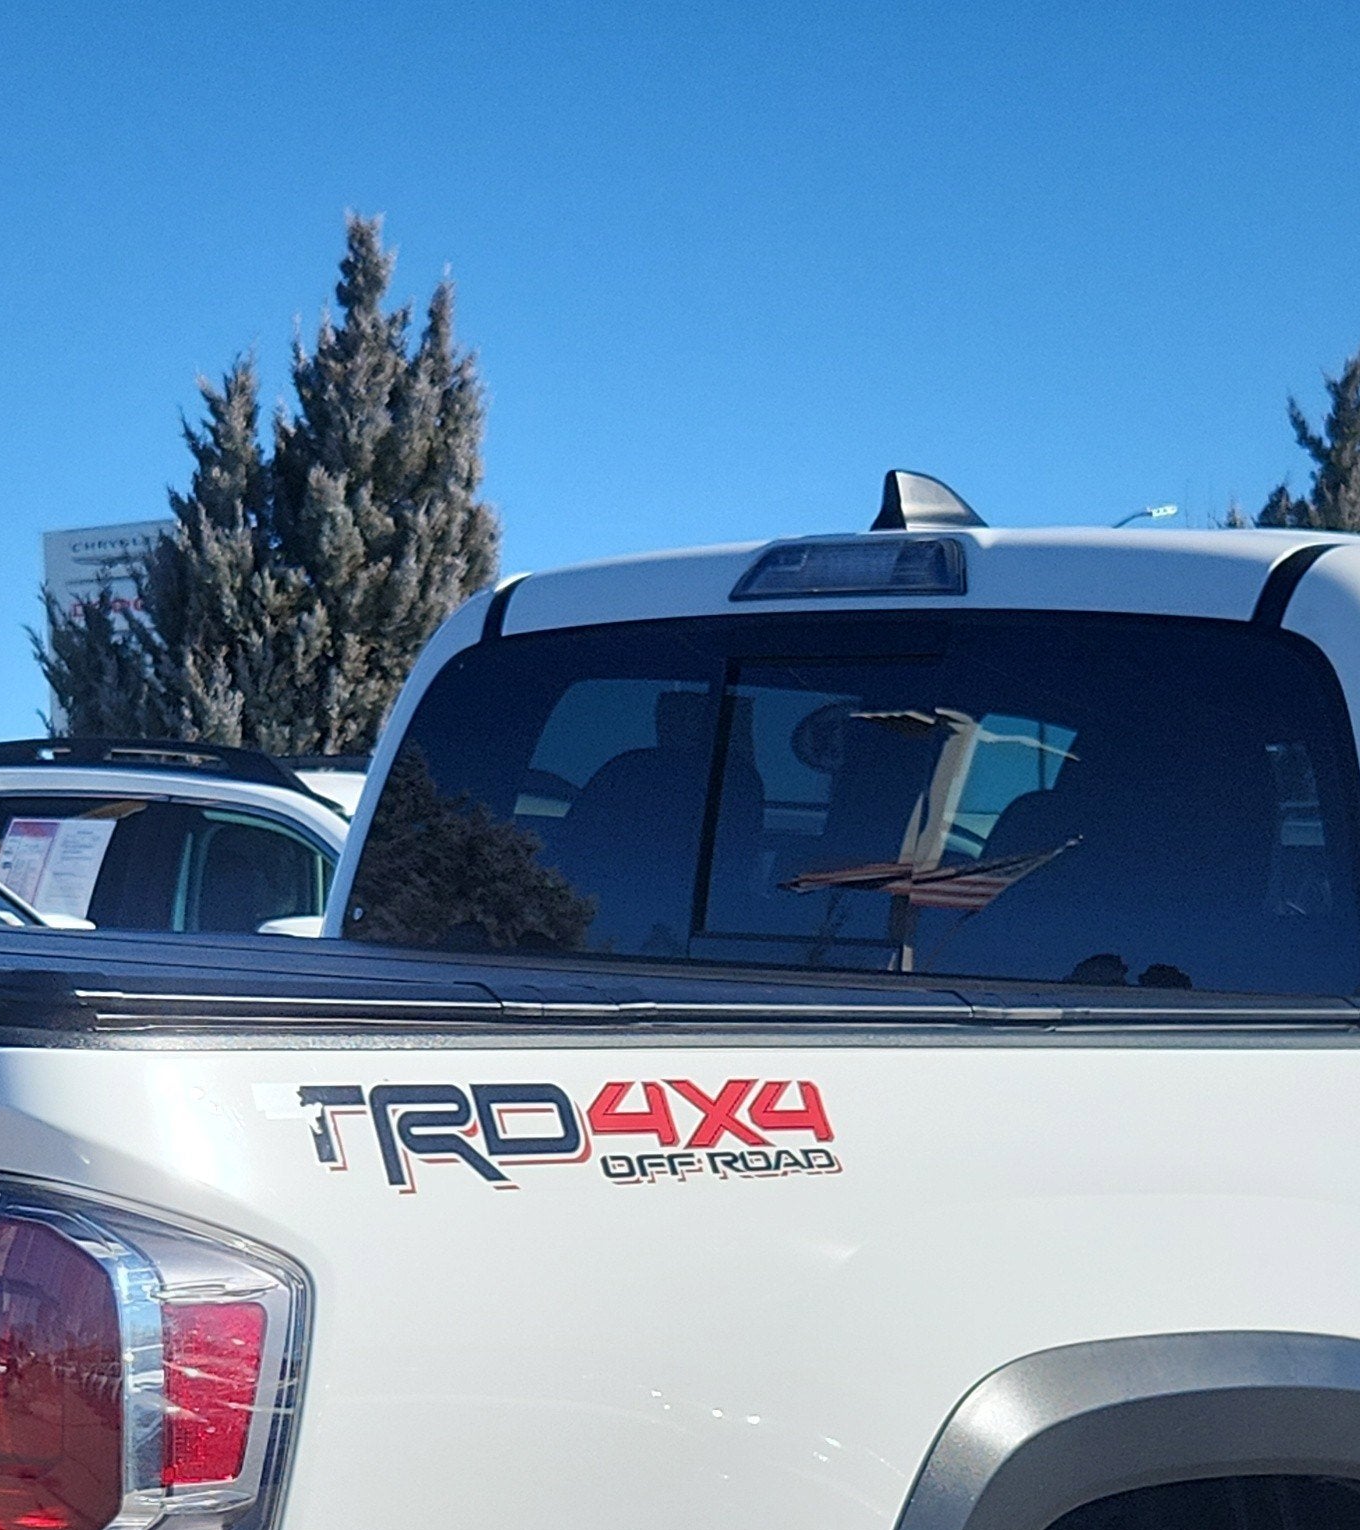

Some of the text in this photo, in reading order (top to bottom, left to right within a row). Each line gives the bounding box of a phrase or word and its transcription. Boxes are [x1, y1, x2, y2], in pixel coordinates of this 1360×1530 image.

[299, 1082, 593, 1194] TRD
[599, 1148, 843, 1185] OFF ROAD
